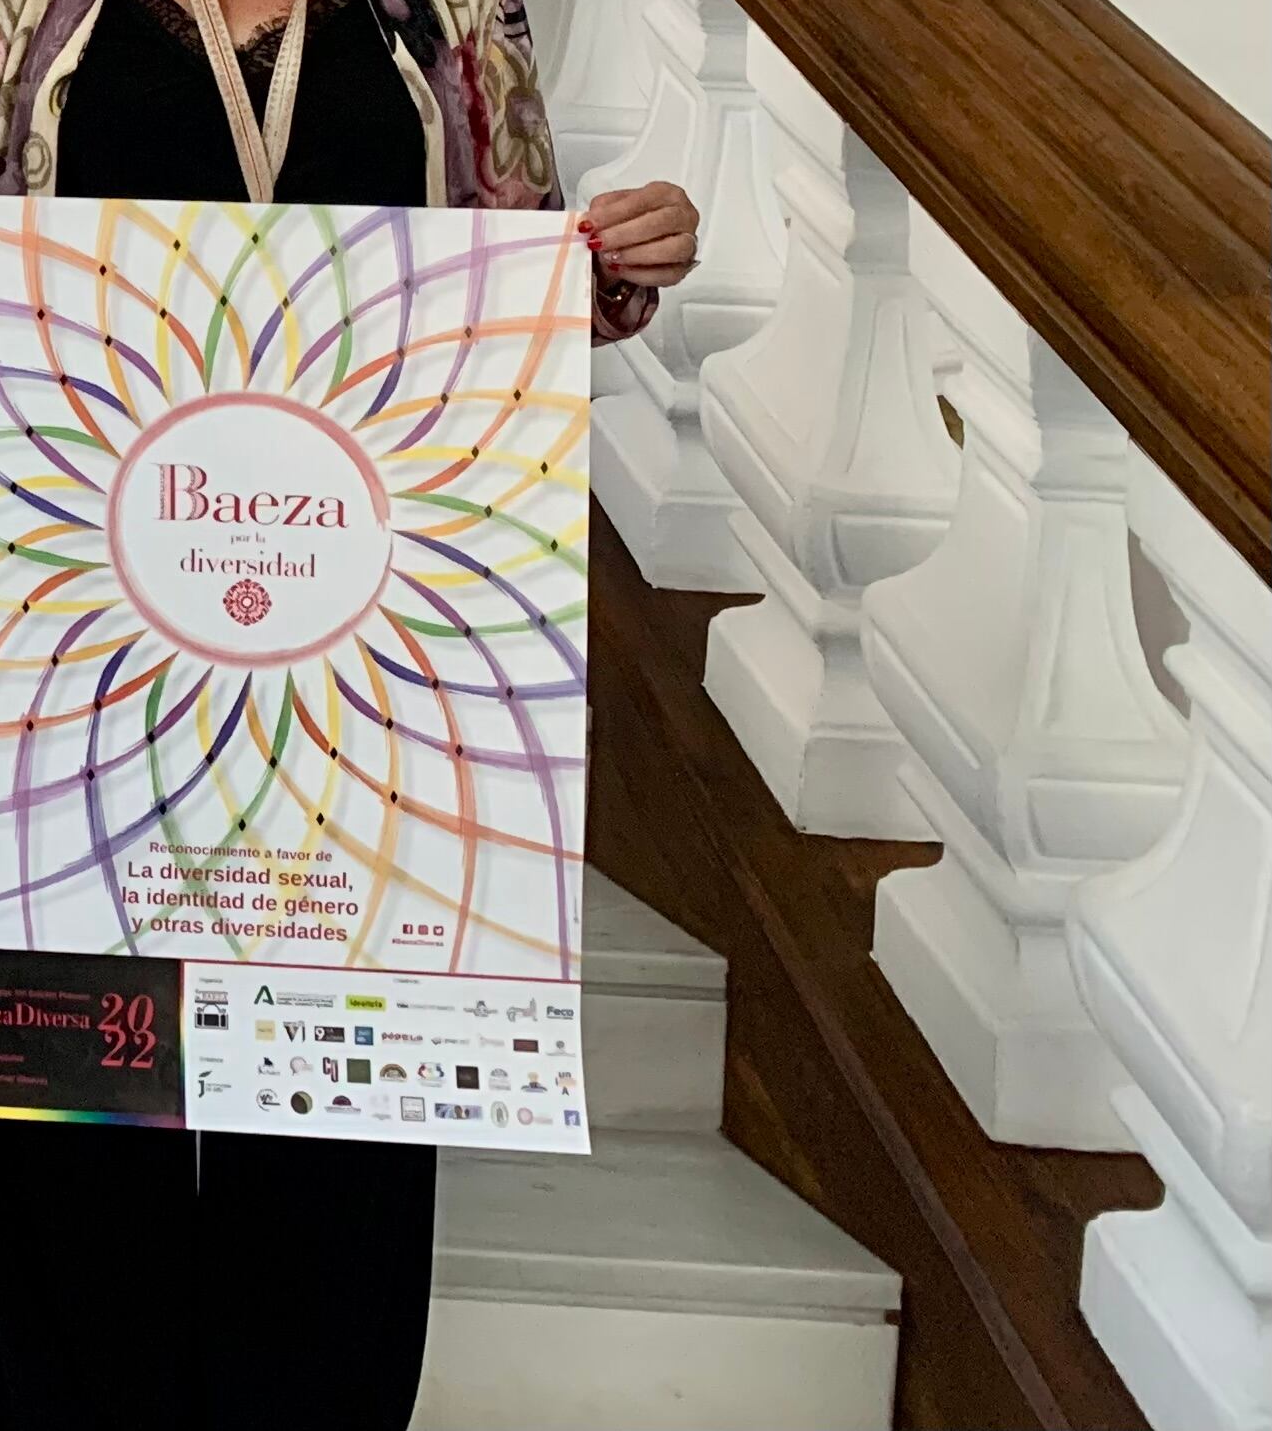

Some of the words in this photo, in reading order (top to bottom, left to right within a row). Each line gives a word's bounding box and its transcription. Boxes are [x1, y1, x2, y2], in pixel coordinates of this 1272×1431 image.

[152, 462, 350, 529] Baeza
[230, 533, 251, 545] por
[255, 532, 266, 543] la
[180, 548, 316, 578] diversidad
[149, 841, 261, 859] Reconocimiento
[264, 849, 272, 859] a
[276, 848, 311, 861] favor
[315, 850, 333, 862] de
[127, 861, 153, 879] La
[160, 861, 271, 885] diversidad
[278, 869, 354, 891] sexual,
[122, 886, 140, 904] la
[147, 887, 245, 910] identidad
[252, 893, 277, 911] de
[284, 896, 359, 917] género
[130, 917, 144, 934] y
[150, 916, 204, 934] otras
[211, 918, 348, 942] diversidades
[97, 992, 155, 1034] 20
[546, 1005, 574, 1017] Feco
[101, 1026, 157, 1069] 22
